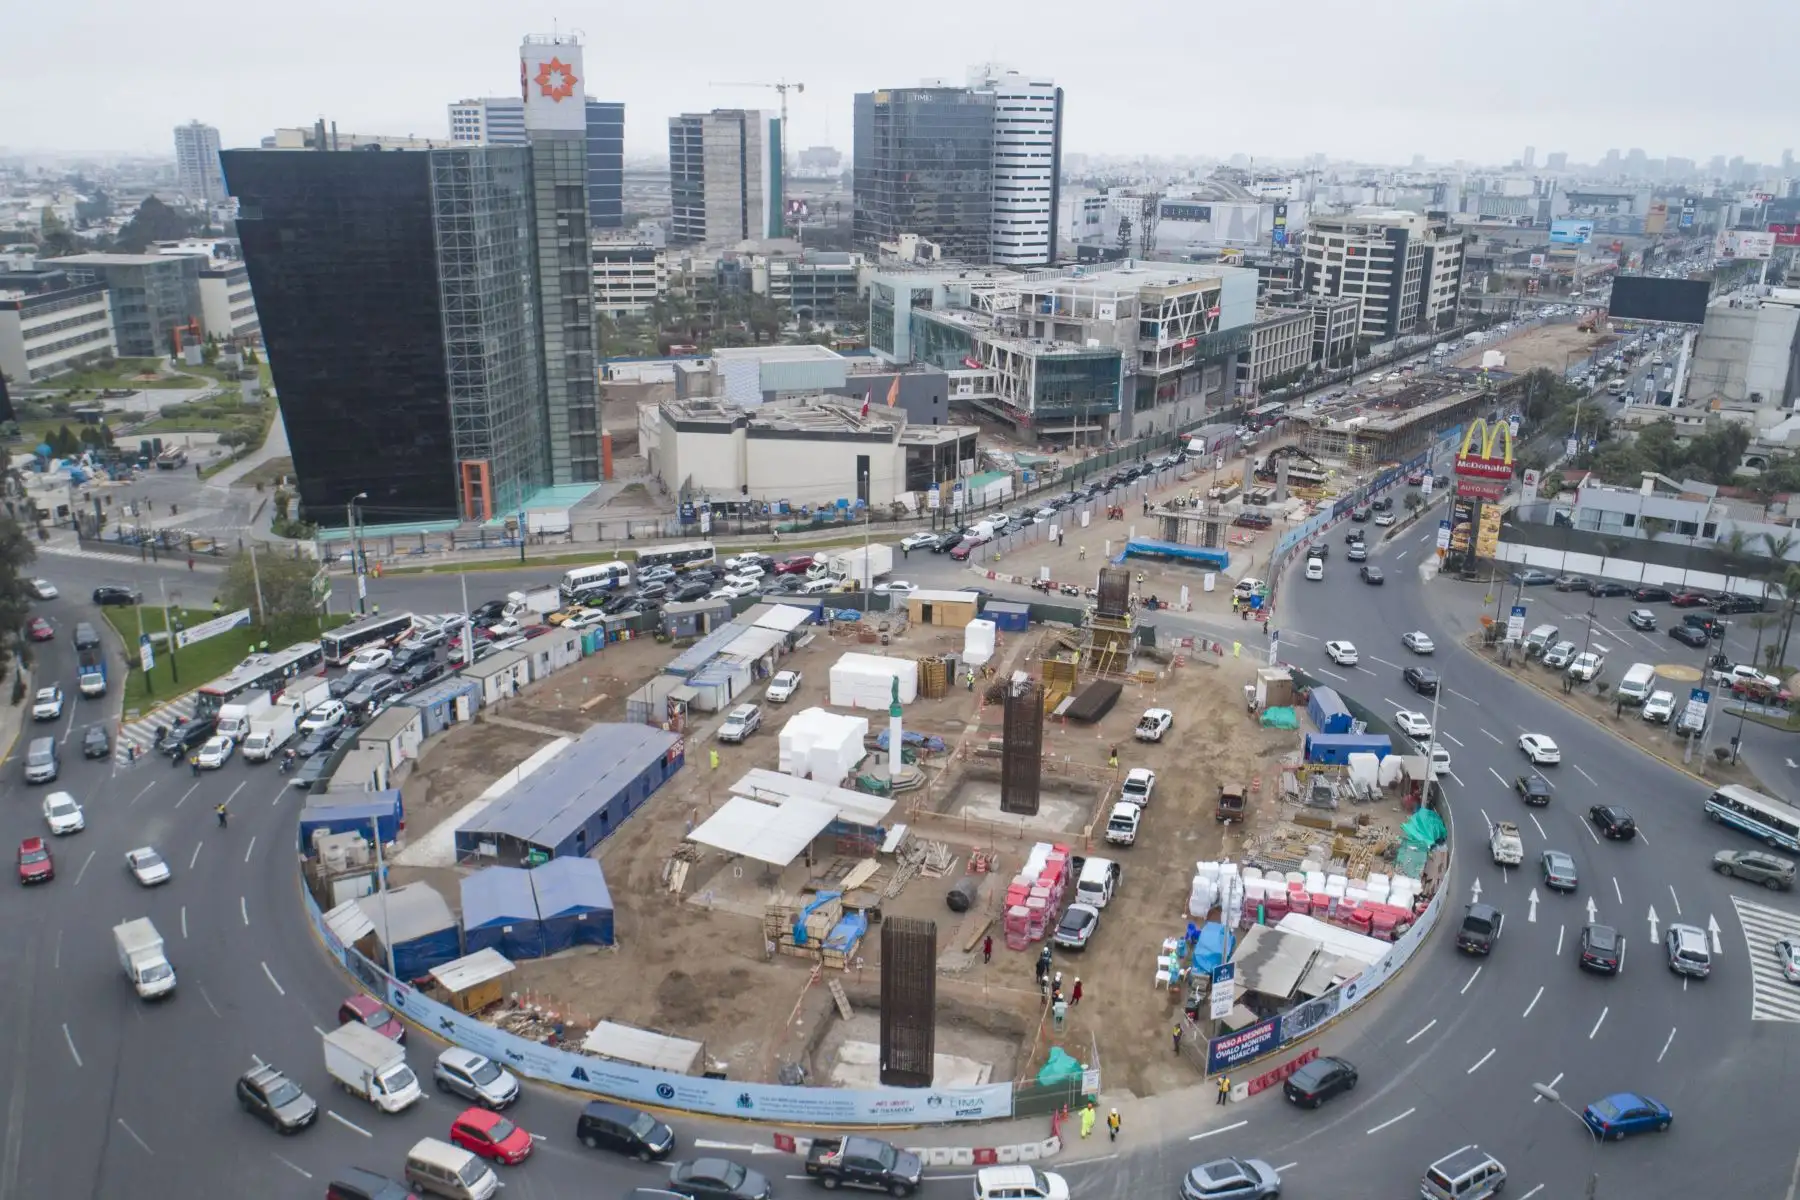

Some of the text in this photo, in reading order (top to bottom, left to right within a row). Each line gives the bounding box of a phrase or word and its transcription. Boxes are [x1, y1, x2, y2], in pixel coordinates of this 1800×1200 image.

[1457, 459, 1512, 473] McDonald's
[1460, 484, 1481, 493] AUTO
[1217, 1037, 1237, 1051] PASO
[1242, 1024, 1272, 1041] DESNIVEL
[1241, 1032, 1272, 1049] MONITOR
